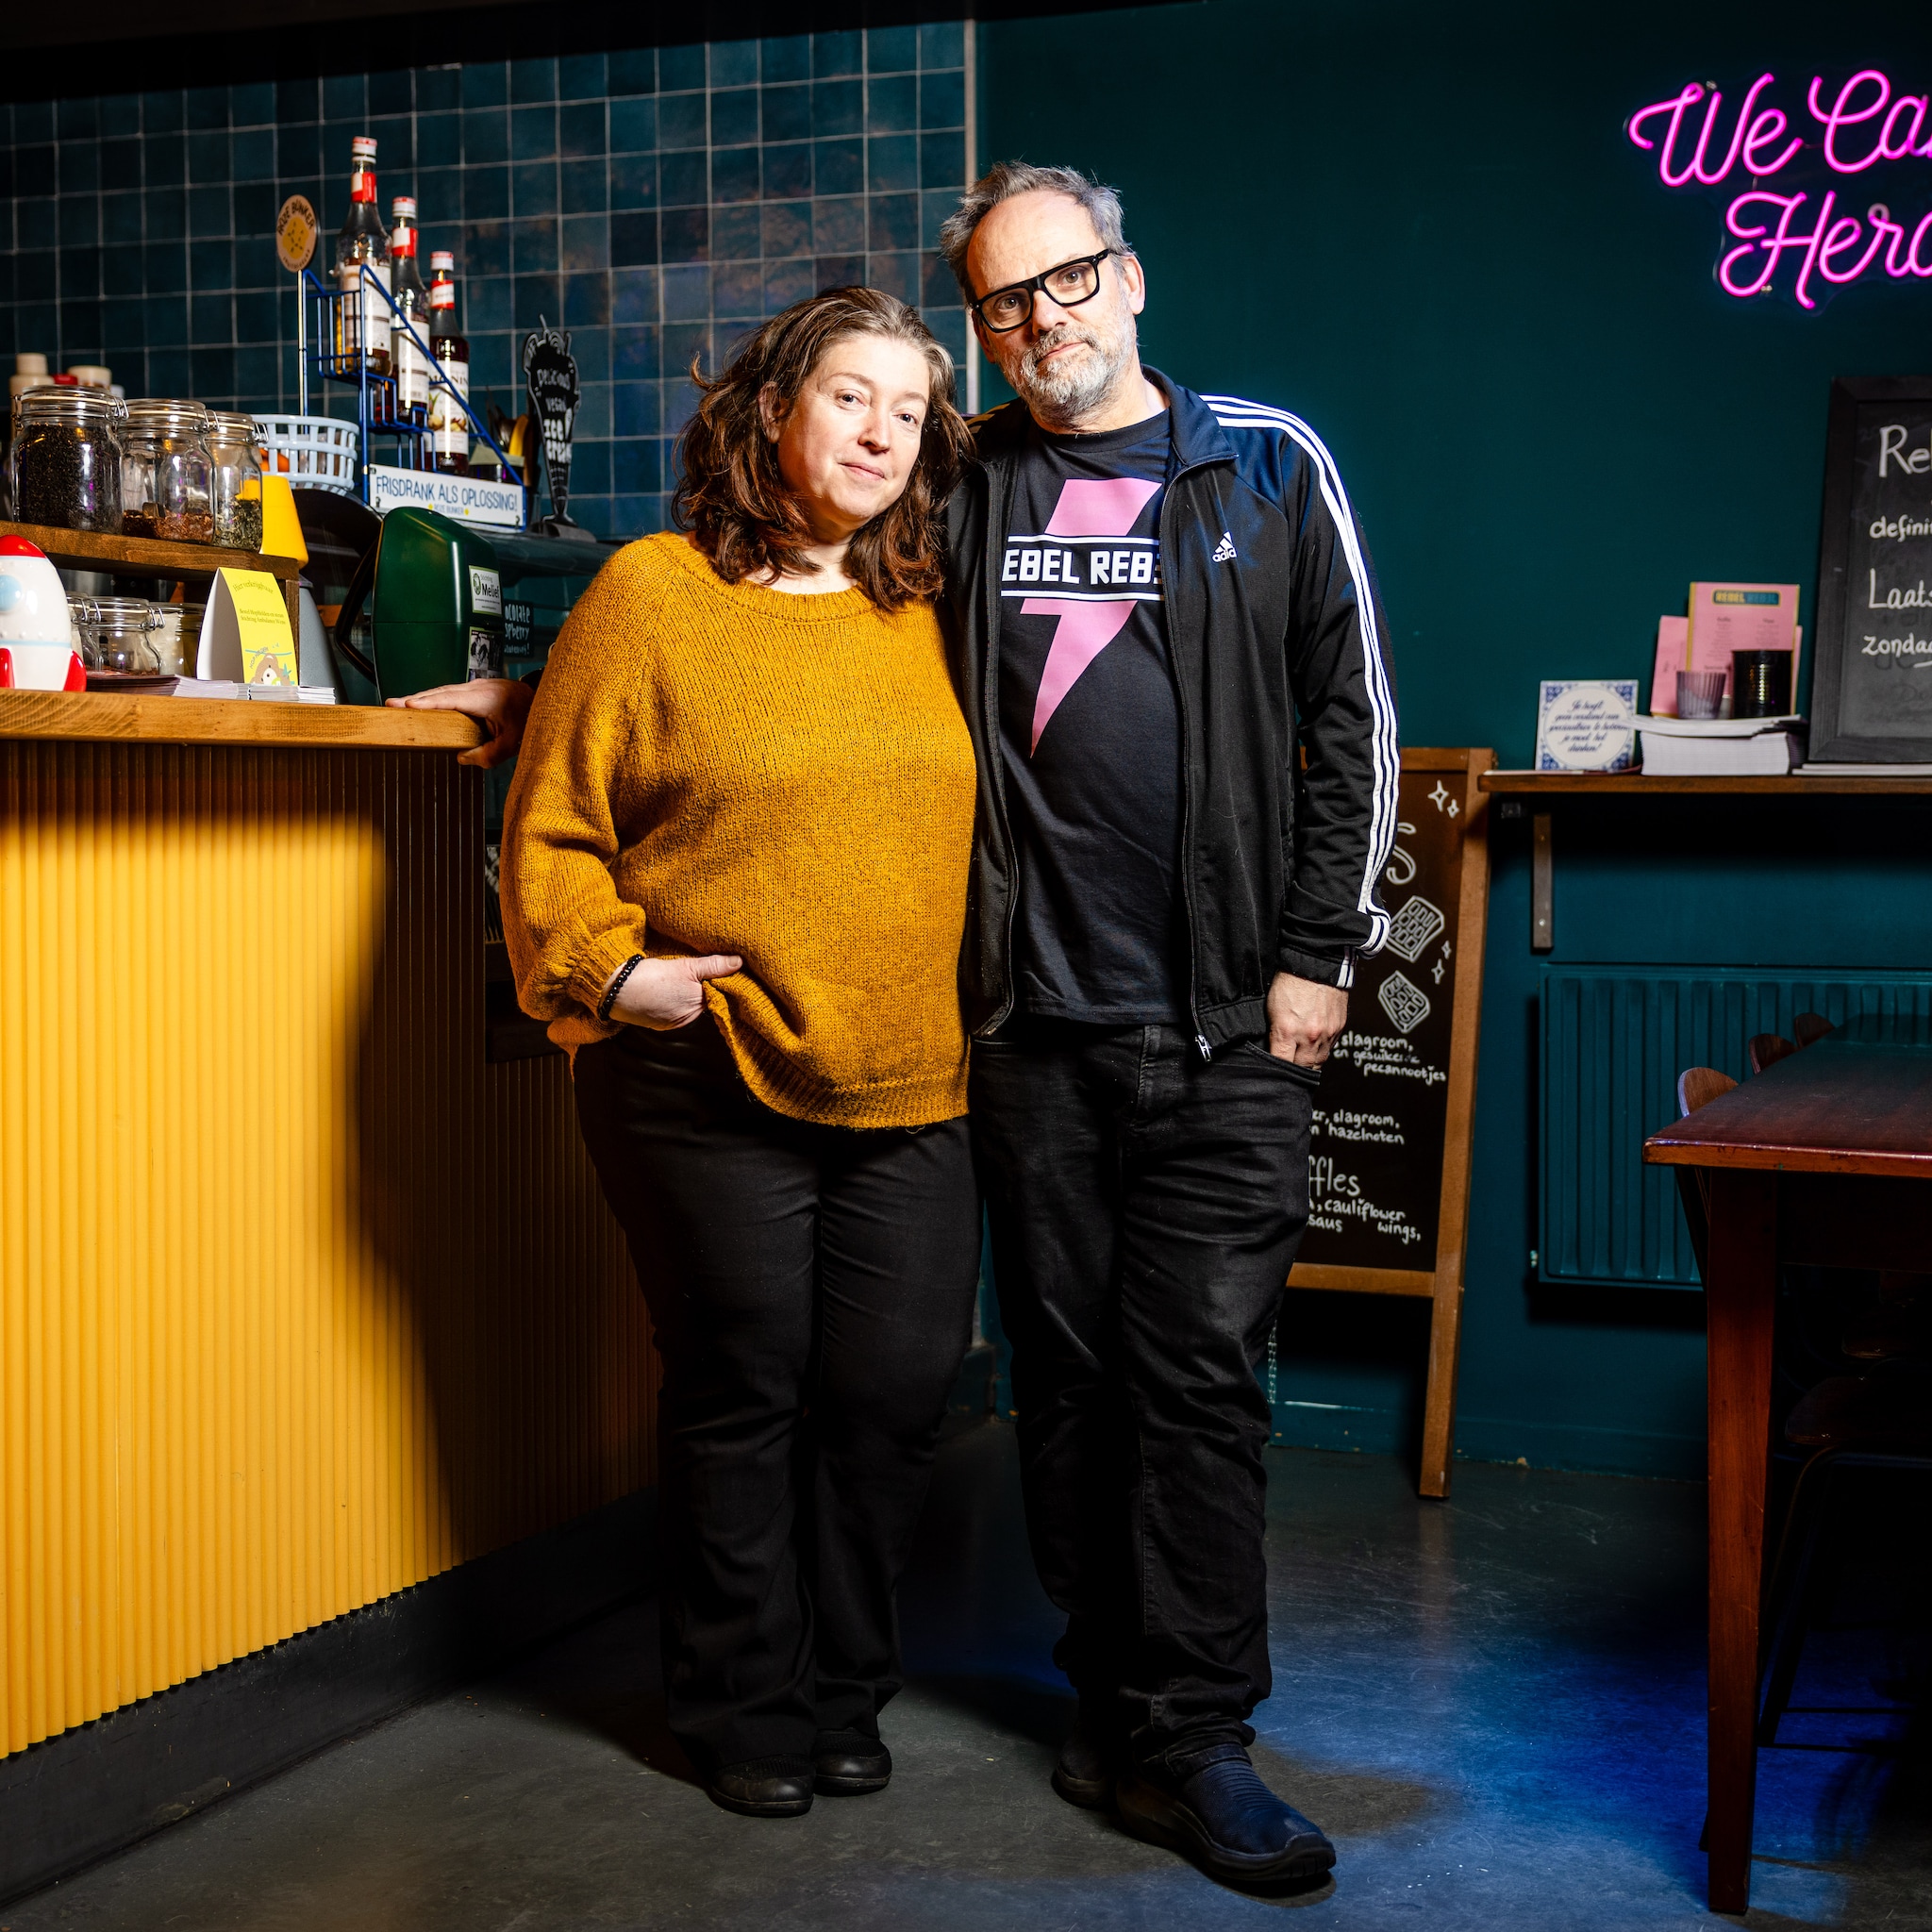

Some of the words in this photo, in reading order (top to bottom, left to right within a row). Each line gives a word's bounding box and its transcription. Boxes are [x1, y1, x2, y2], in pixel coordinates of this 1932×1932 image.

[1628, 72, 1804, 187] We
[1807, 70, 1932, 173] Ca
[1878, 424, 1932, 478] Re
[376, 475, 435, 501] FRISDRANK
[438, 483, 458, 504] ALS
[461, 487, 518, 512] OPLOSSING!
[1364, 1062, 1447, 1085] pecannootjes
[1333, 1108, 1400, 1128] slagroom,
[1328, 1123, 1406, 1144] hazelnoten
[1377, 1221, 1422, 1244] wings,
